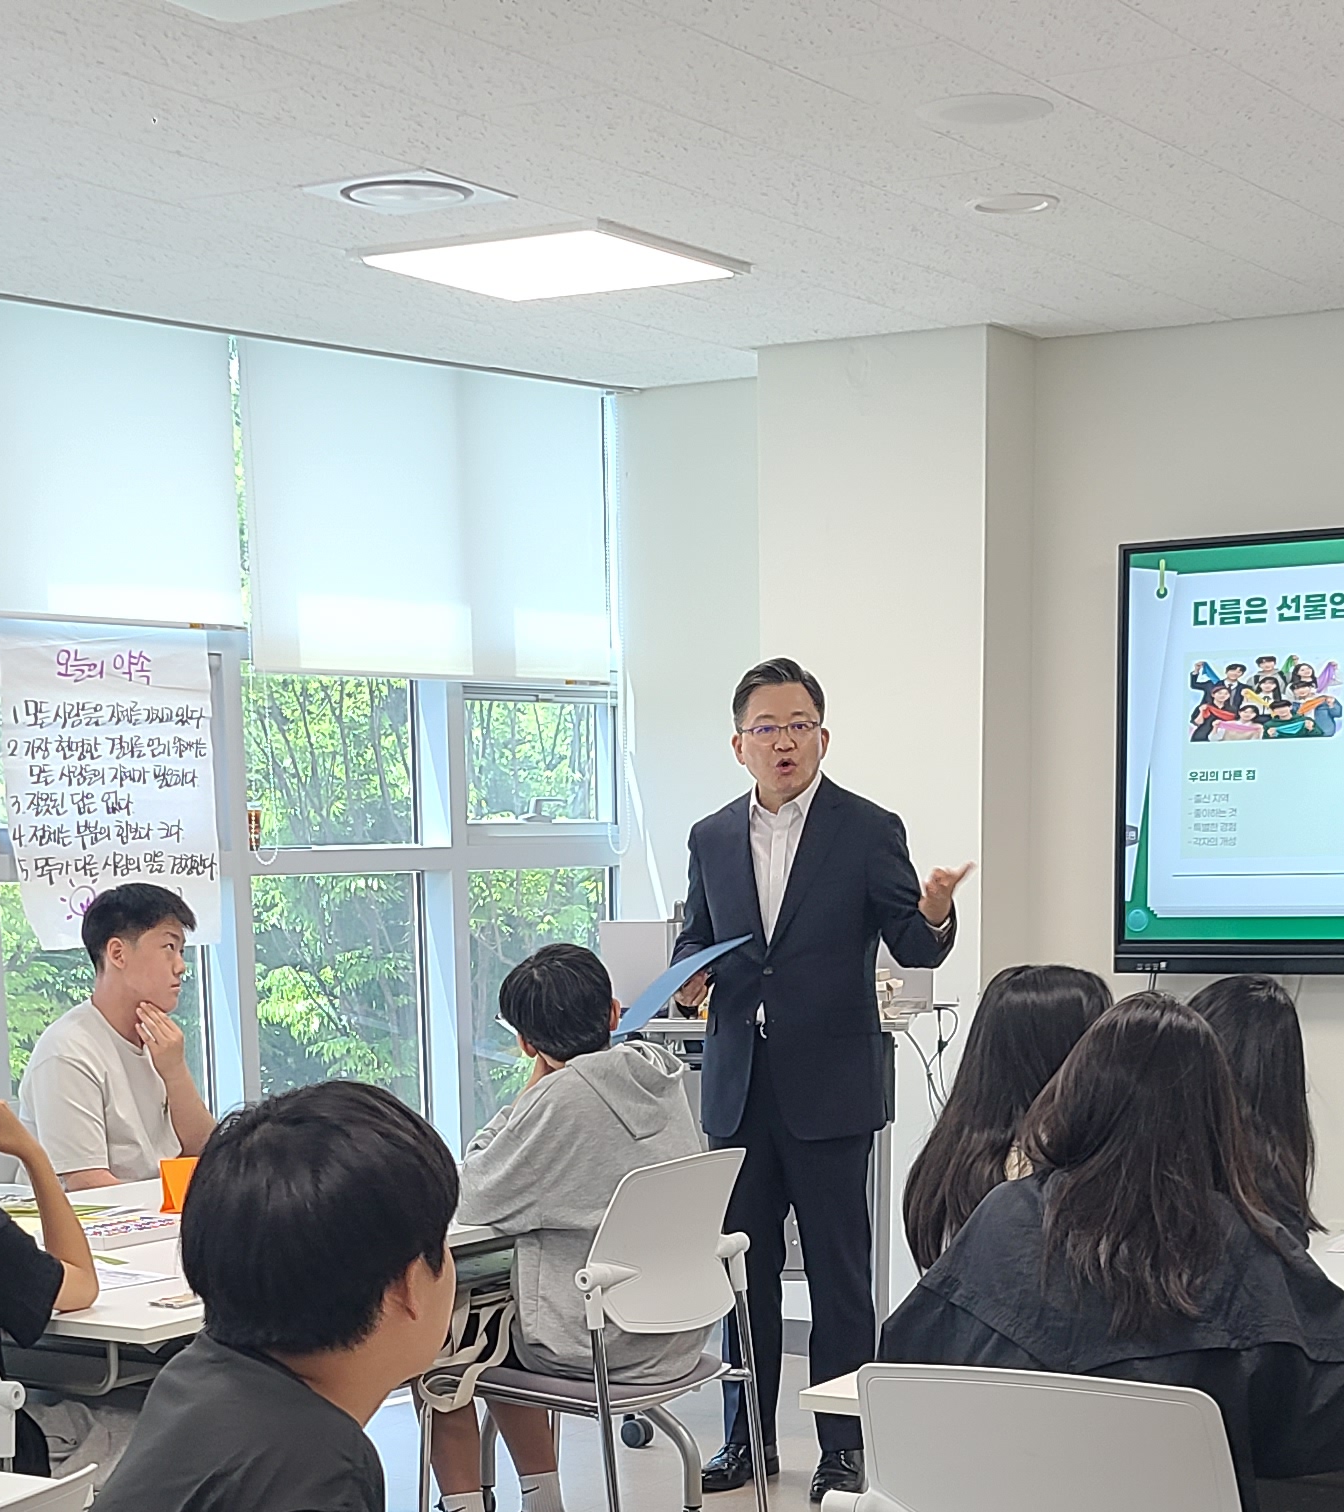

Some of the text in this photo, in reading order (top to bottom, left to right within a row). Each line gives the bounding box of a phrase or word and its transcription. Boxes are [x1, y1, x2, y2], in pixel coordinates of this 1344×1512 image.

[1193, 596, 1268, 626] 다름은
[57, 649, 151, 685] 오늘의 약속
[24, 699, 52, 729] 모든
[23, 737, 52, 760] 가장
[55, 735, 102, 761] 현명한
[105, 735, 146, 760] 결과를
[29, 764, 54, 786] 모든
[58, 764, 105, 787] 사람들의
[1188, 769, 1256, 782] 우리의 다른 점
[26, 791, 68, 817] 잘못된
[70, 792, 97, 816] 답은
[1212, 793, 1229, 803] 지역
[1228, 807, 1237, 818] 것
[28, 823, 72, 848] 전체는
[75, 820, 111, 850] 부분의
[1219, 836, 1237, 847] 개성
[34, 857, 71, 886] 모두가
[74, 853, 99, 878] 다른
[102, 851, 141, 877] 사람의
[144, 850, 165, 875] 말을
